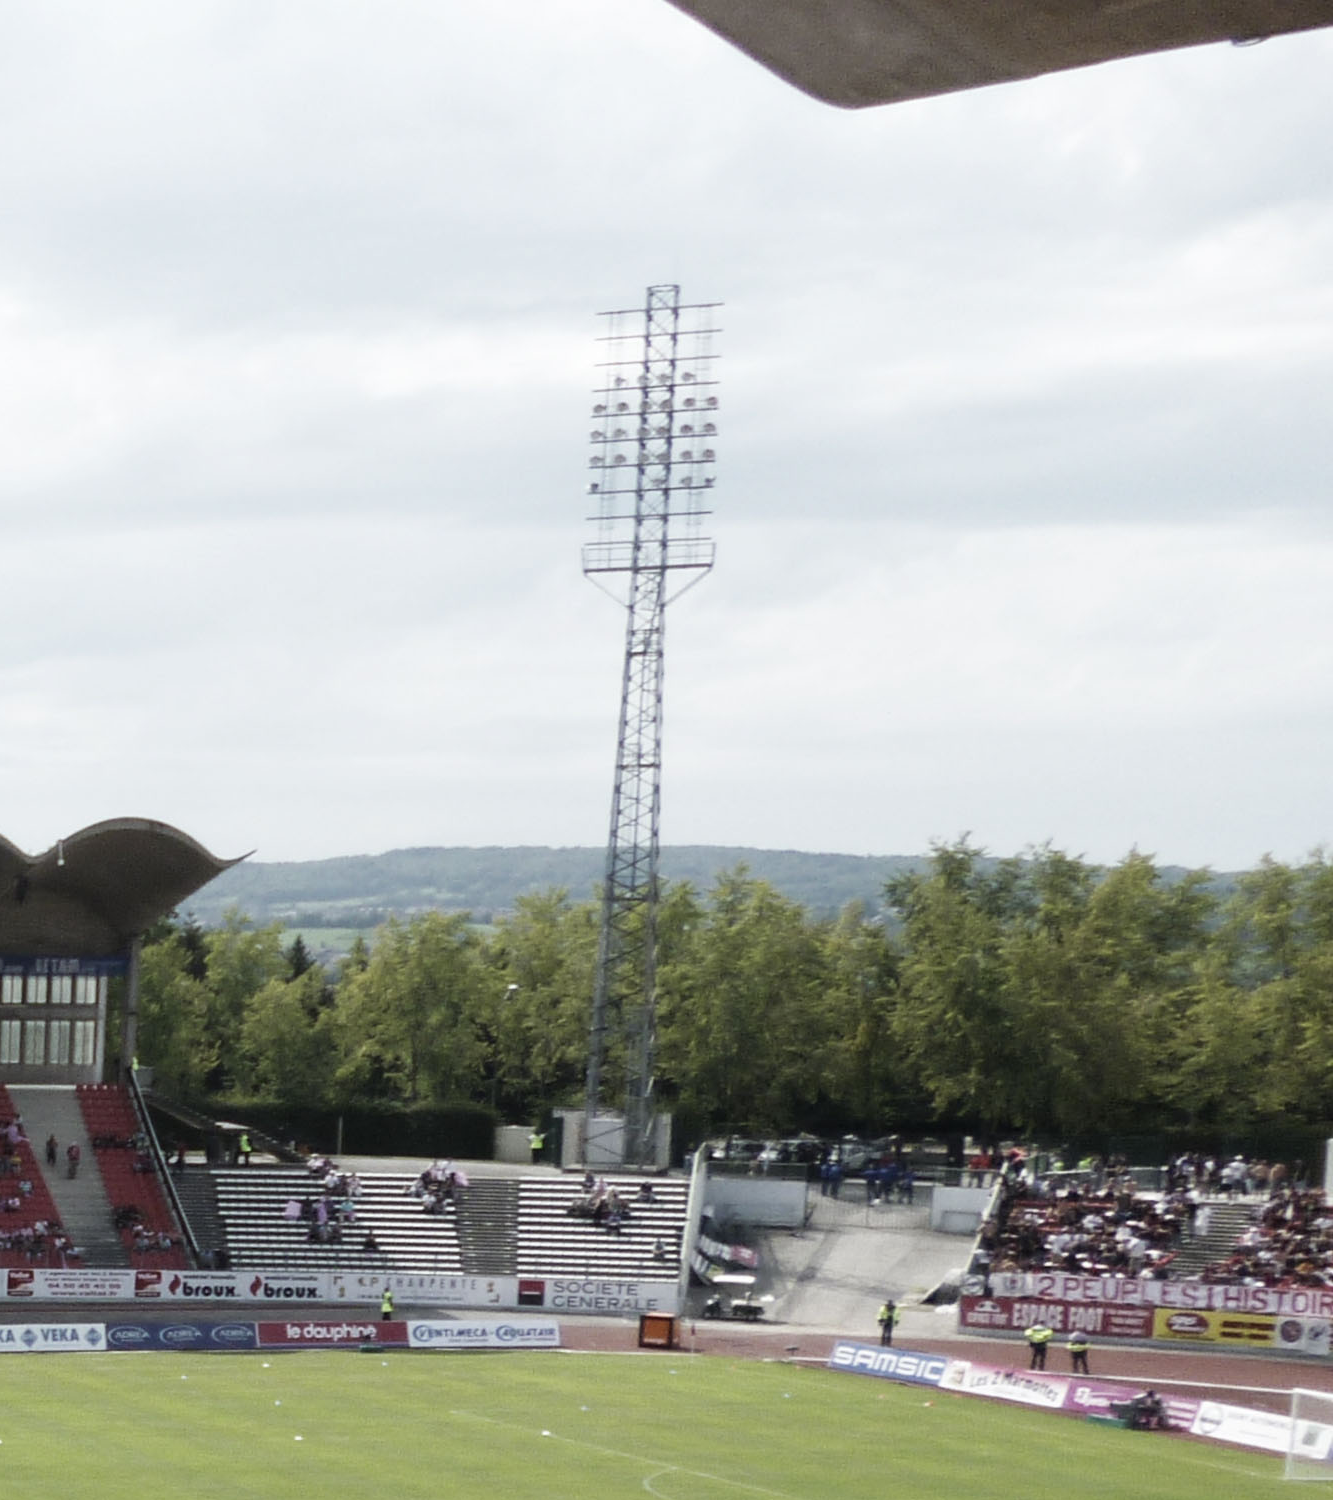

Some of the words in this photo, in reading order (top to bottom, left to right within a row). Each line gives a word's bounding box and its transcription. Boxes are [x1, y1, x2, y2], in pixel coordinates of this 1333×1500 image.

[182, 1282, 233, 1296] broux
[259, 1283, 311, 1297] broux
[385, 1277, 477, 1289] CHARPENTE
[553, 1281, 639, 1297] SOCIETE
[1038, 1276, 1056, 1297] 2
[1063, 1277, 1199, 1307] PEUPLES
[1012, 1303, 1064, 1329] ESPACE
[1069, 1306, 1104, 1332] FOOT
[40, 1329, 80, 1343] VEKA
[287, 1324, 301, 1338] le
[418, 1326, 489, 1338] VENTIMECA
[502, 1327, 556, 1338] AQUATAIR
[833, 1345, 946, 1380] SAMSIC
[1003, 1372, 1060, 1402] Marmottes
